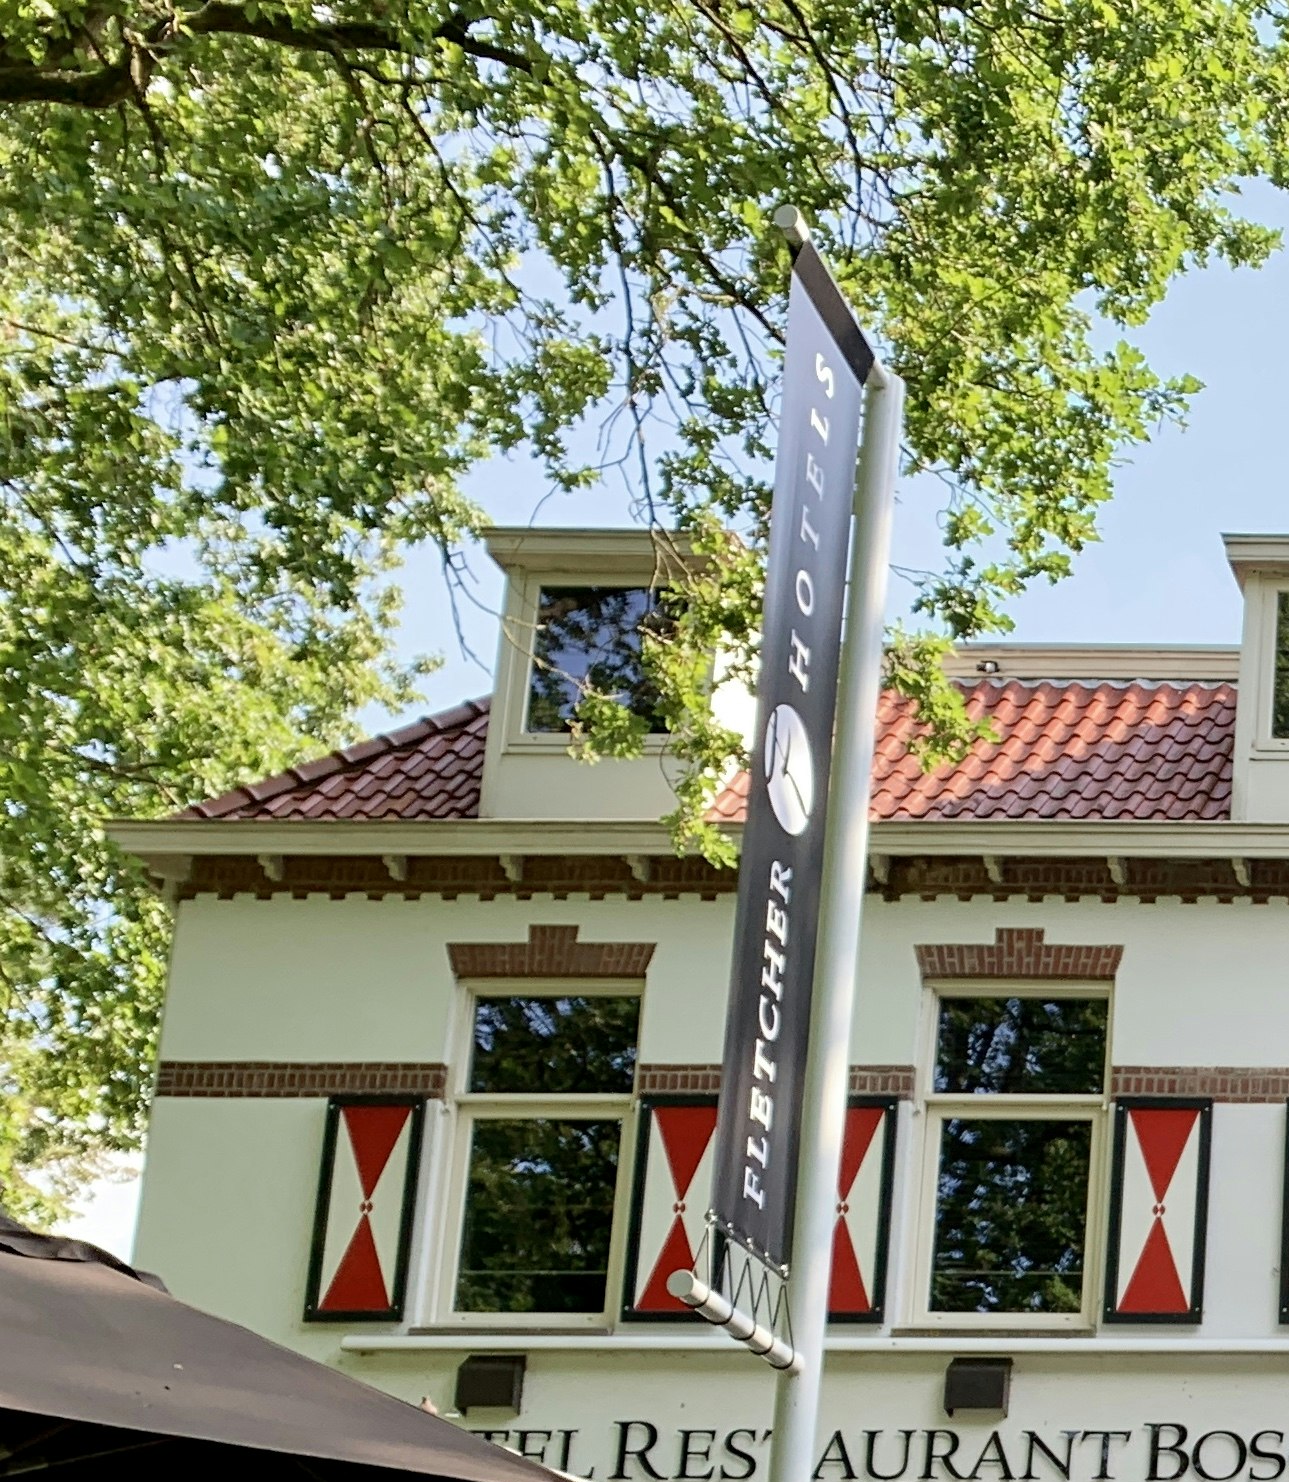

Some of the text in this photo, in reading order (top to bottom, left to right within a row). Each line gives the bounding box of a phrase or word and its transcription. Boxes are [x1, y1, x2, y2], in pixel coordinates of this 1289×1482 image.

[743, 351, 837, 1211] FLETCHER HOTELS
[607, 1420, 1132, 1482] RESAURANT
